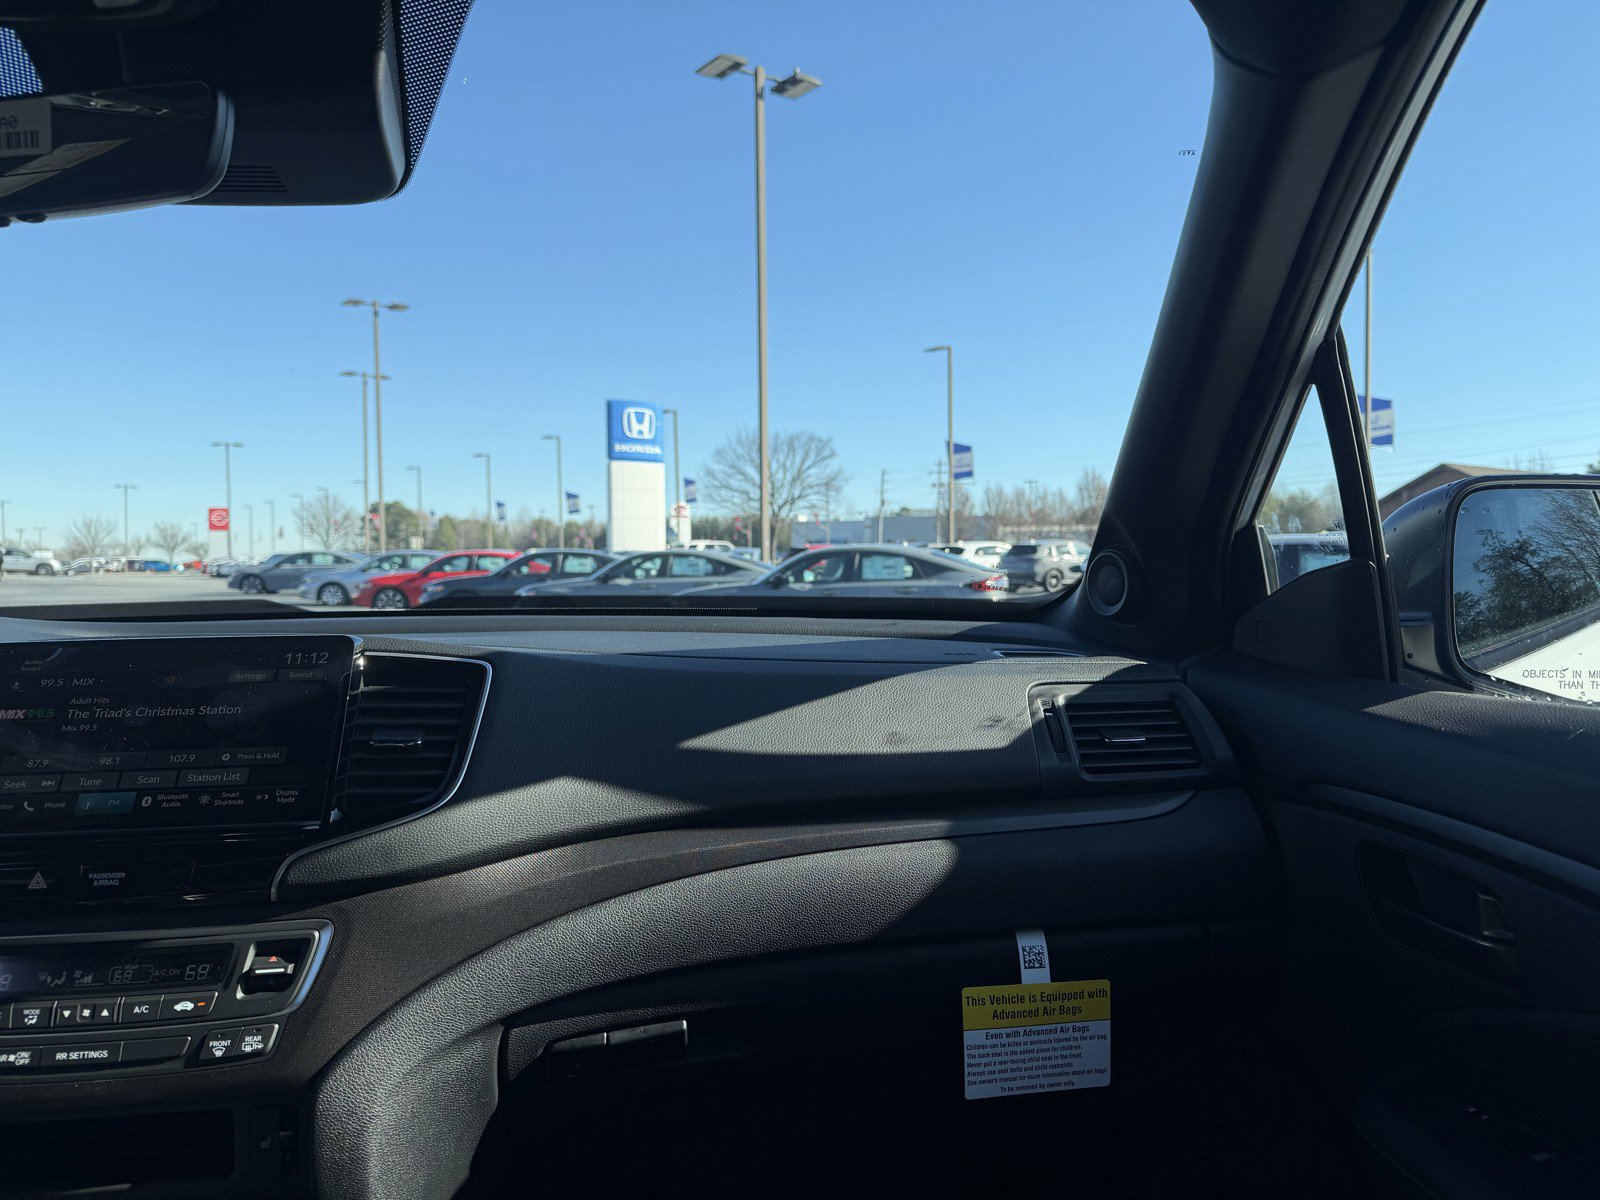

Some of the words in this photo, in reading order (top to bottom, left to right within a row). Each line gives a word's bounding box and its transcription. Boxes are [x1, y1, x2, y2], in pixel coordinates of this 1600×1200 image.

[285, 652, 328, 664] 11:12
[1522, 670, 1565, 678] OBJECTS
[1572, 670, 1582, 678] IN
[40, 679, 64, 687] 99.5
[72, 678, 95, 686] MIX
[1558, 680, 1584, 689] THAN
[0, 709, 27, 719] MIX
[27, 709, 55, 718] 99.5
[67, 709, 90, 718] The
[94, 708, 132, 718] Triad's
[135, 706, 195, 717] Christmas
[198, 705, 241, 715] Station
[100, 757, 120, 766] 98.1
[169, 754, 195, 763] 107.9
[26, 760, 48, 768] 87.9
[80, 778, 102, 786] Tune
[137, 776, 160, 784] Scan
[187, 773, 221, 782] Station
[3, 780, 27, 788] Seek
[113, 970, 133, 982] 68
[169, 968, 180, 976] ON
[966, 996, 985, 1006] This
[989, 994, 1025, 1005] Vehicle
[1029, 993, 1036, 1002] is
[1041, 990, 1084, 1003] Equipped
[1088, 988, 1107, 998] with
[133, 1005, 149, 1014] A/C
[993, 1008, 1038, 1020] Advanced
[1043, 1007, 1055, 1016] Air
[1060, 1005, 1082, 1016] Bags
[986, 1031, 1003, 1040] Even
[1005, 1030, 1020, 1038] with
[1023, 1027, 1057, 1037] Advanced
[1060, 1026, 1070, 1034] Air
[1072, 1024, 1089, 1033] Bags
[56, 1052, 68, 1060] RR
[69, 1050, 108, 1060] SETTINGS
